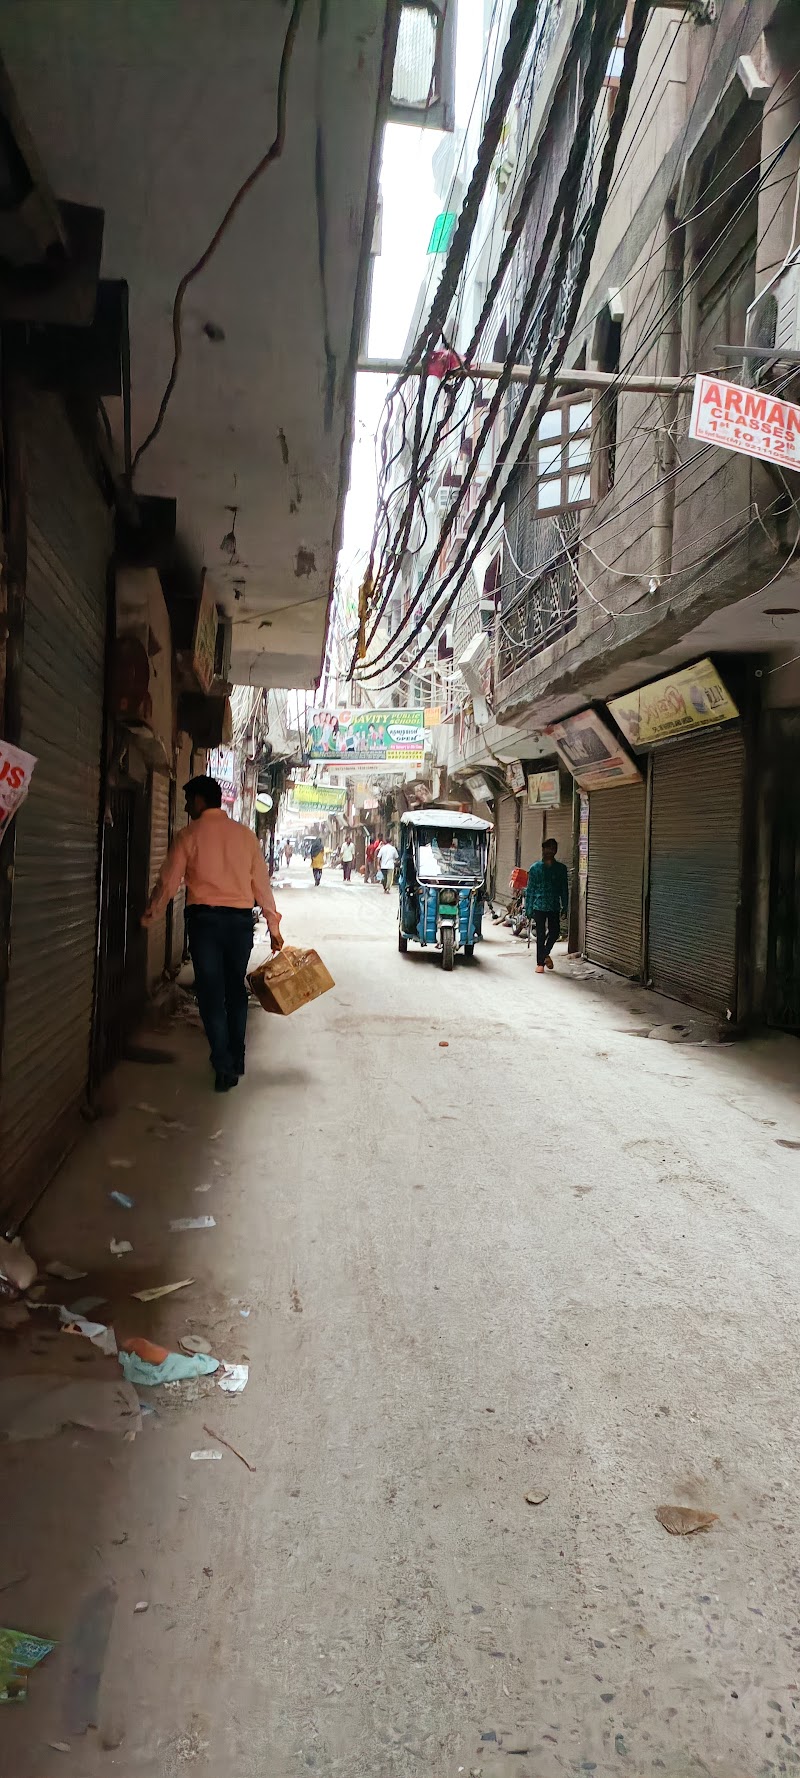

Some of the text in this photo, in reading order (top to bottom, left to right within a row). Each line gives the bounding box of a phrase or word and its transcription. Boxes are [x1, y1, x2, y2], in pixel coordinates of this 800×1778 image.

[703, 384, 800, 434] ARMAN
[711, 407, 795, 442] CLASSES
[734, 428, 754, 442] to
[339, 711, 390, 725] GRAVITY
